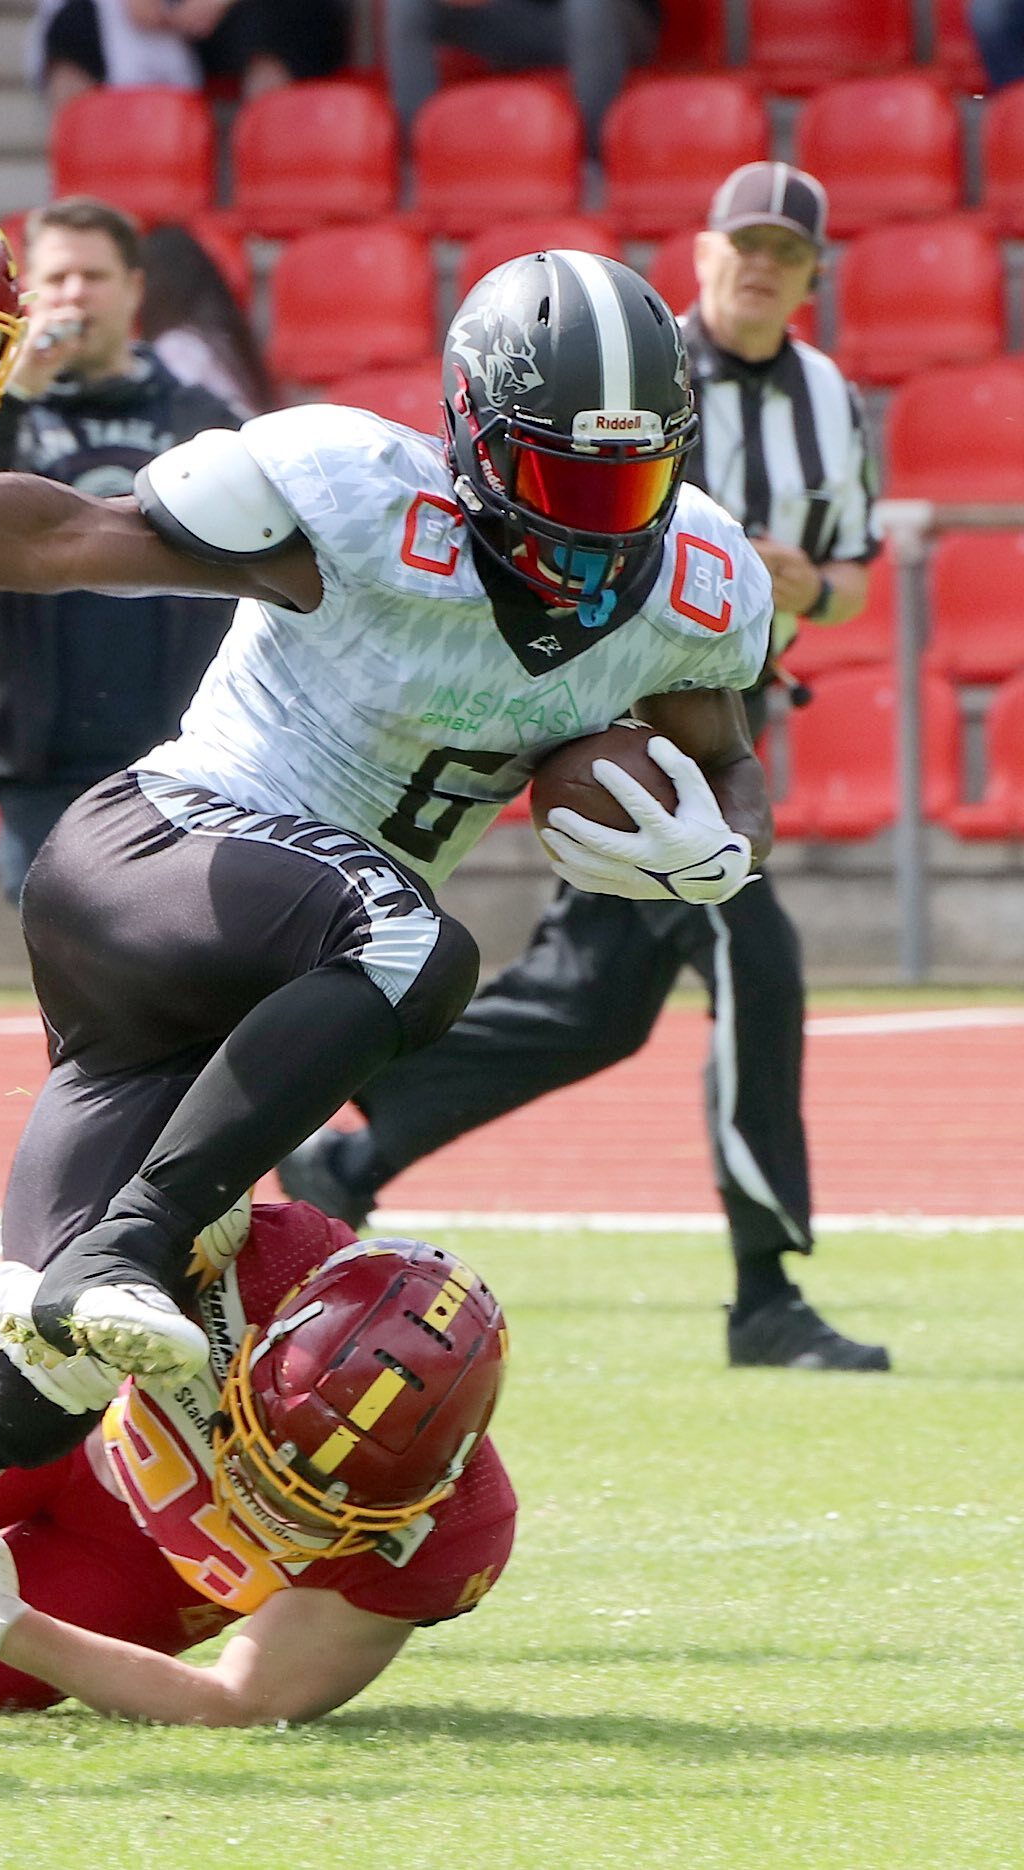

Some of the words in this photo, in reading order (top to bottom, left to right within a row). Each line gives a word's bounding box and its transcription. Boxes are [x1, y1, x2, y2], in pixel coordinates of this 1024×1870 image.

[595, 415, 642, 430] Riddell
[420, 711, 480, 735] GMBH
[427, 684, 574, 736] INSIRAS
[378, 745, 519, 863] 6
